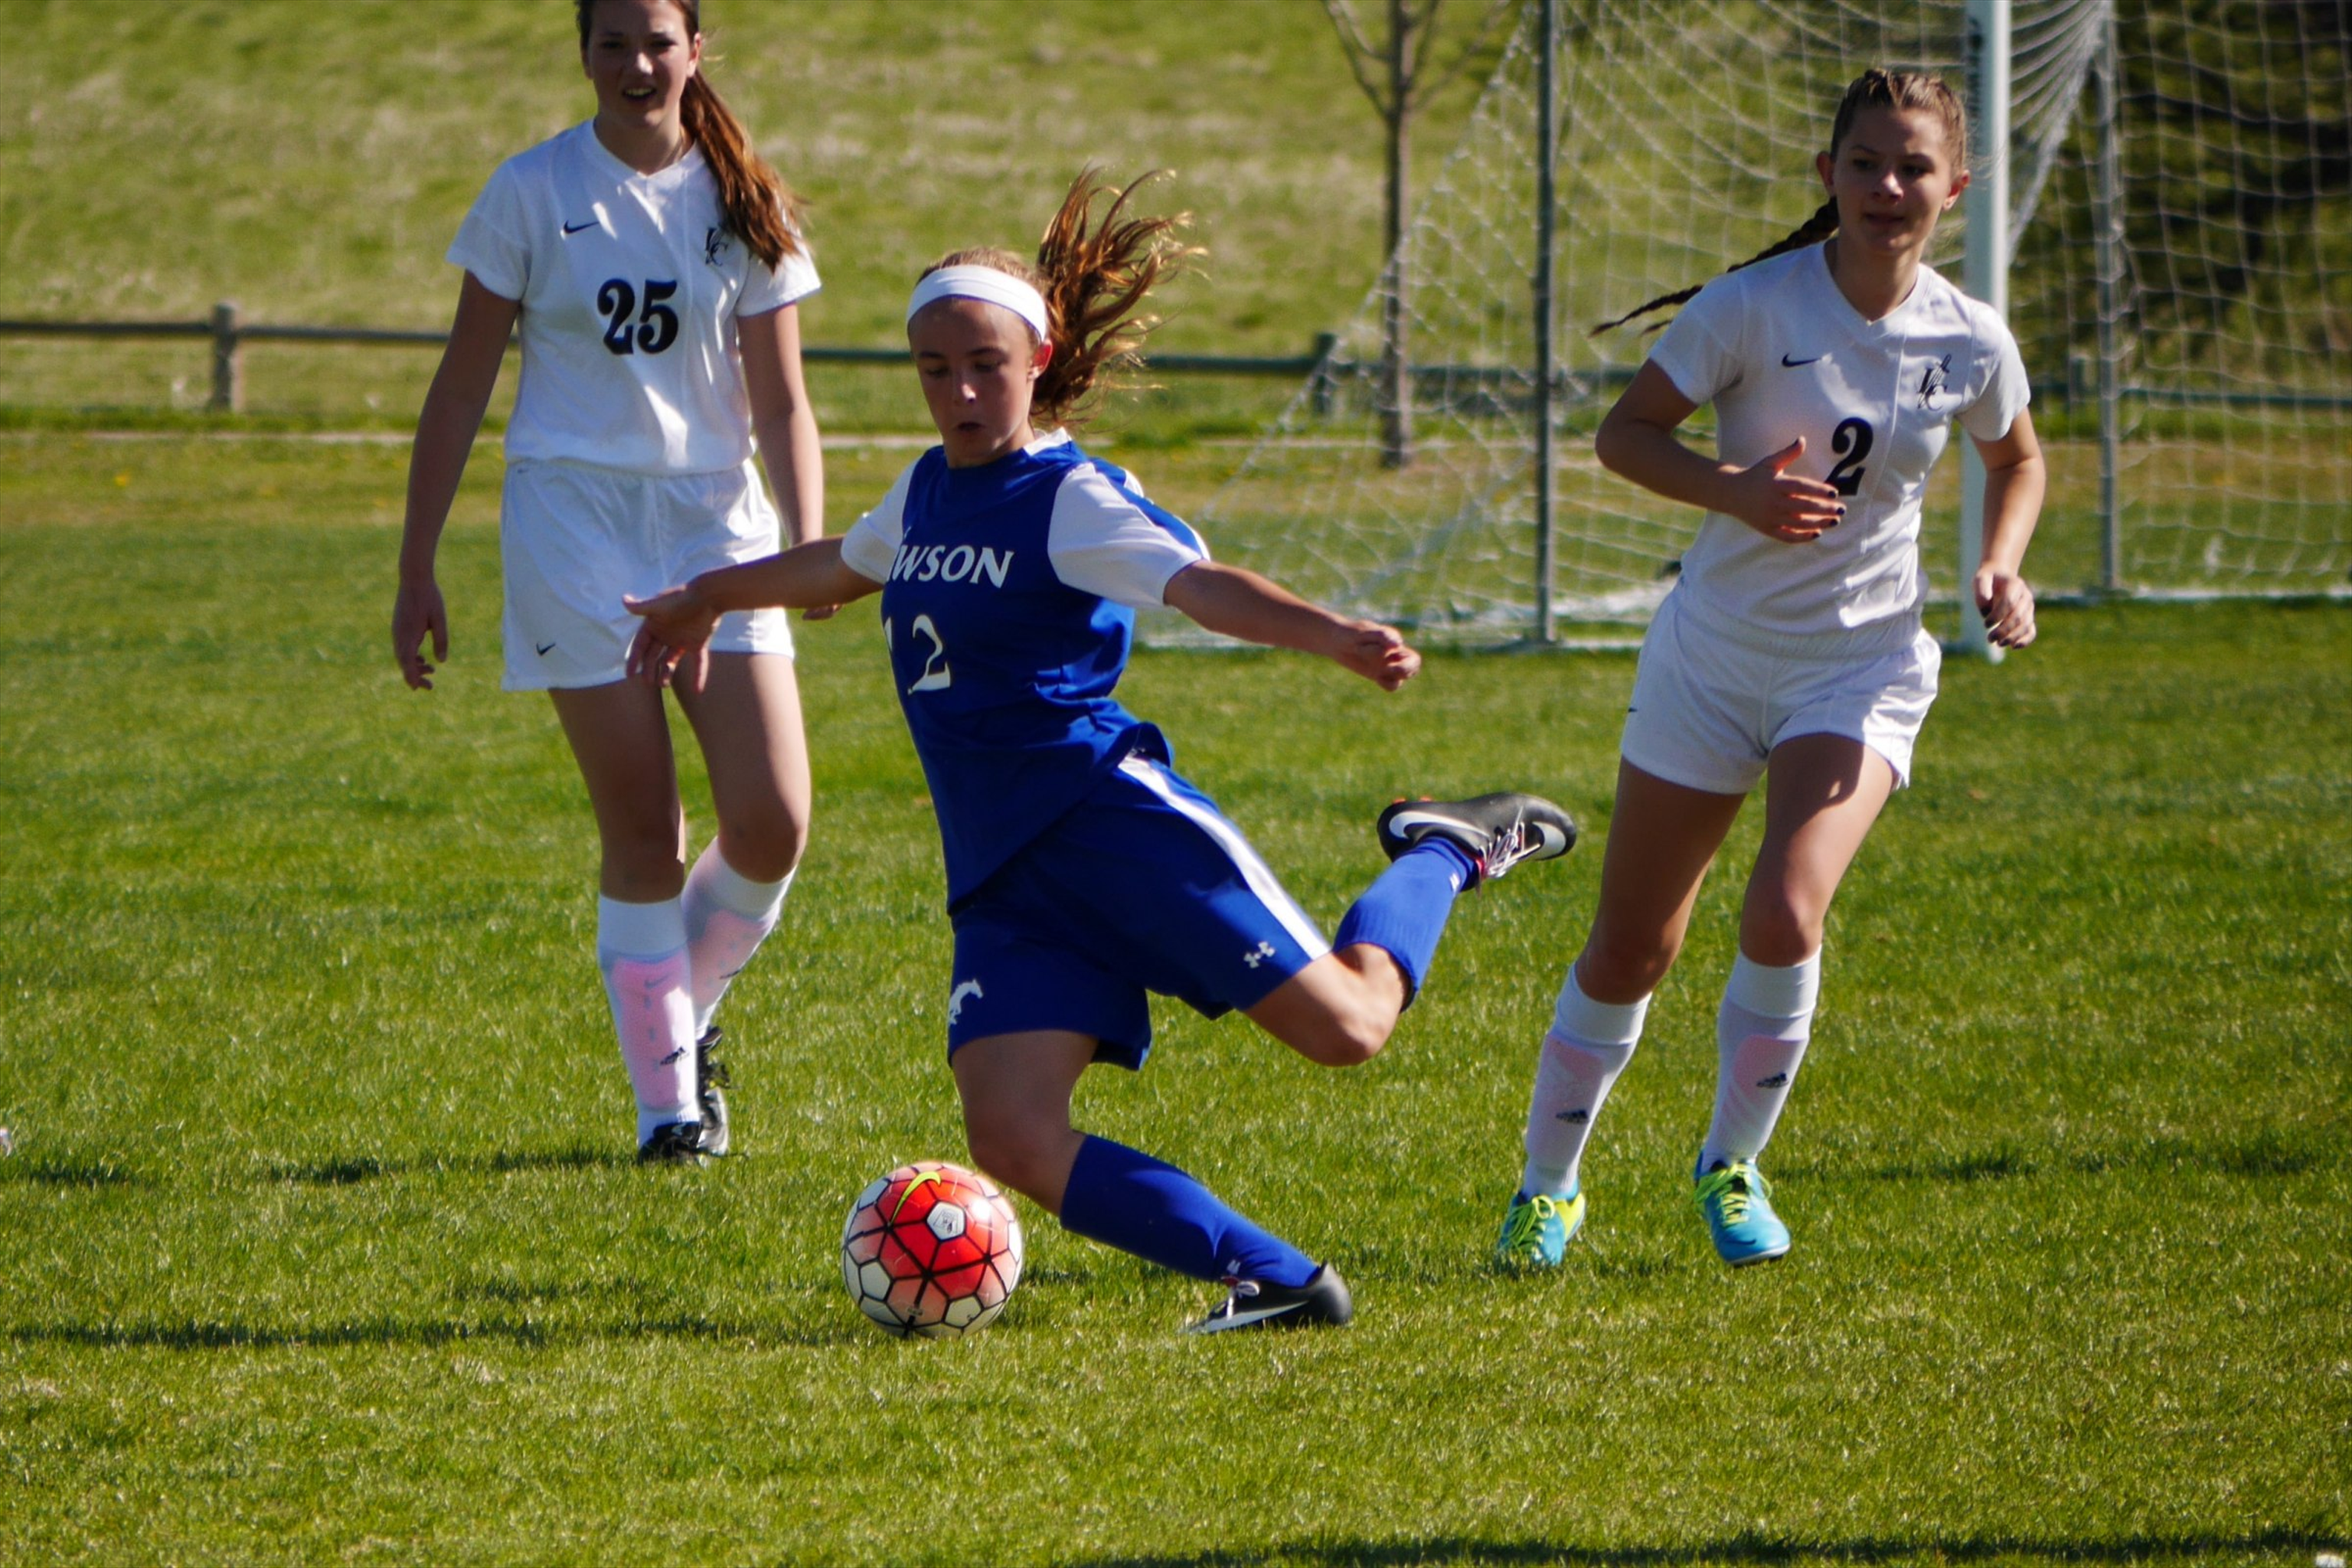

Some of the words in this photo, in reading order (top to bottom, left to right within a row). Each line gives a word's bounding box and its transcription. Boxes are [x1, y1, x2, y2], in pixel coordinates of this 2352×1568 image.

[597, 278, 678, 355] 25
[1824, 417, 1873, 495] 2
[887, 544, 1014, 589] WSON
